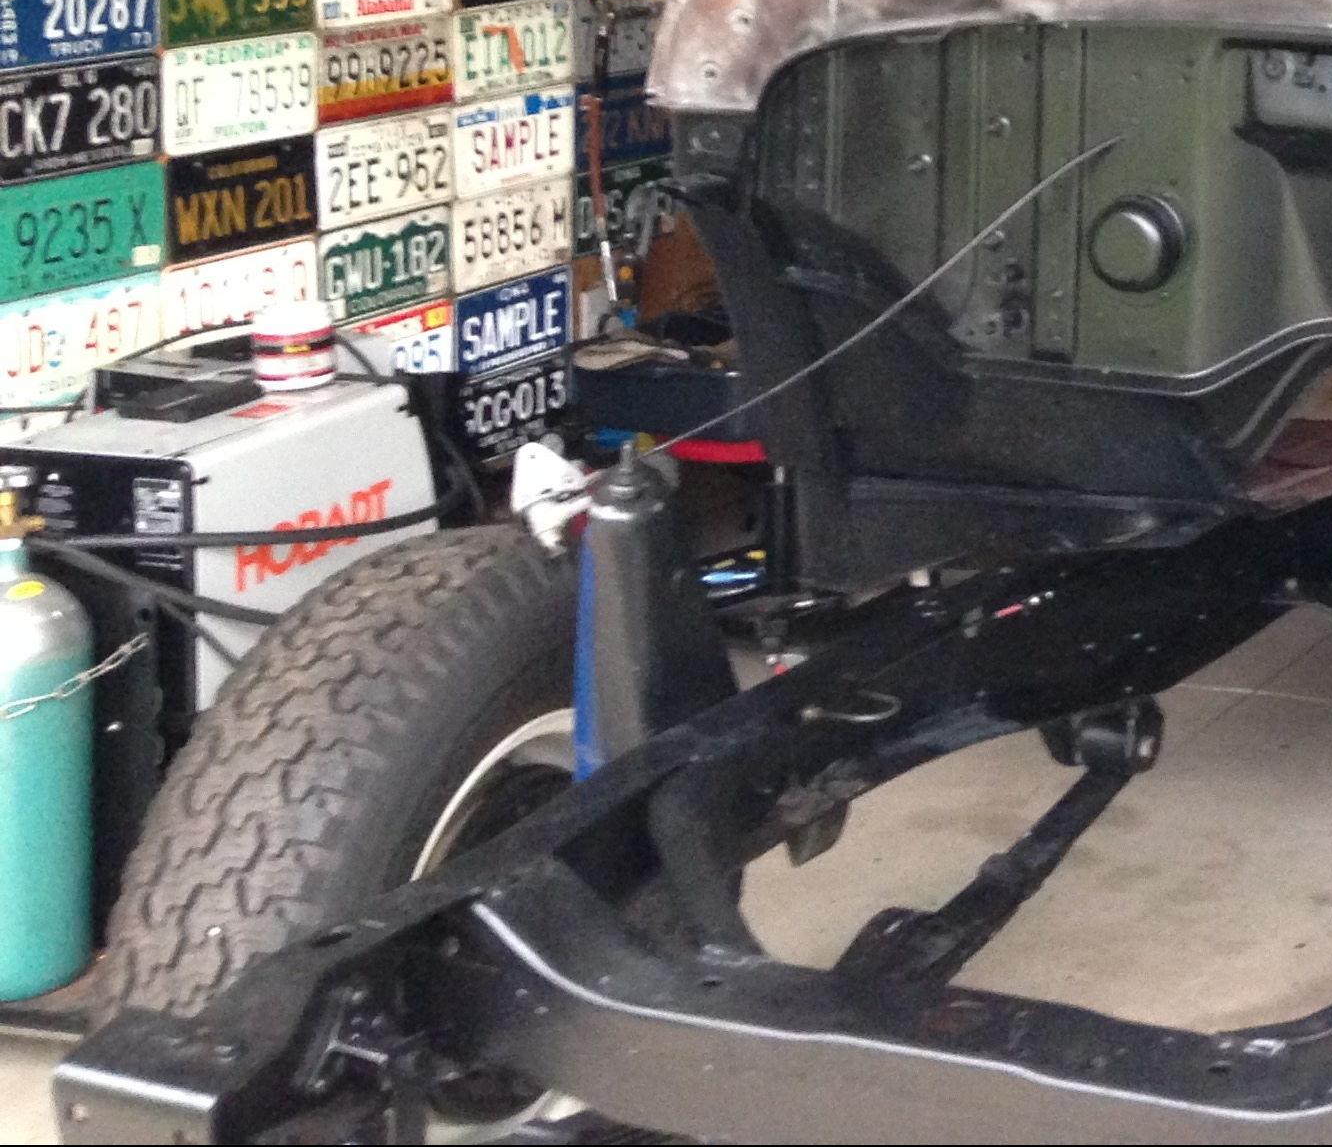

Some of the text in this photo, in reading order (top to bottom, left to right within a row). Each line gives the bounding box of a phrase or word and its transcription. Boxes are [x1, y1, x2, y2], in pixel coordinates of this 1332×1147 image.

[49, 36, 104, 58] TRUCK
[519, 21, 568, 72] 012
[87, 80, 157, 145] 280
[472, 113, 562, 175] SAMPLE
[16, 193, 147, 268] 9235 X
[253, 172, 312, 229] 201
[461, 290, 563, 362] SAMPLE
[234, 478, 394, 593] HOBART
